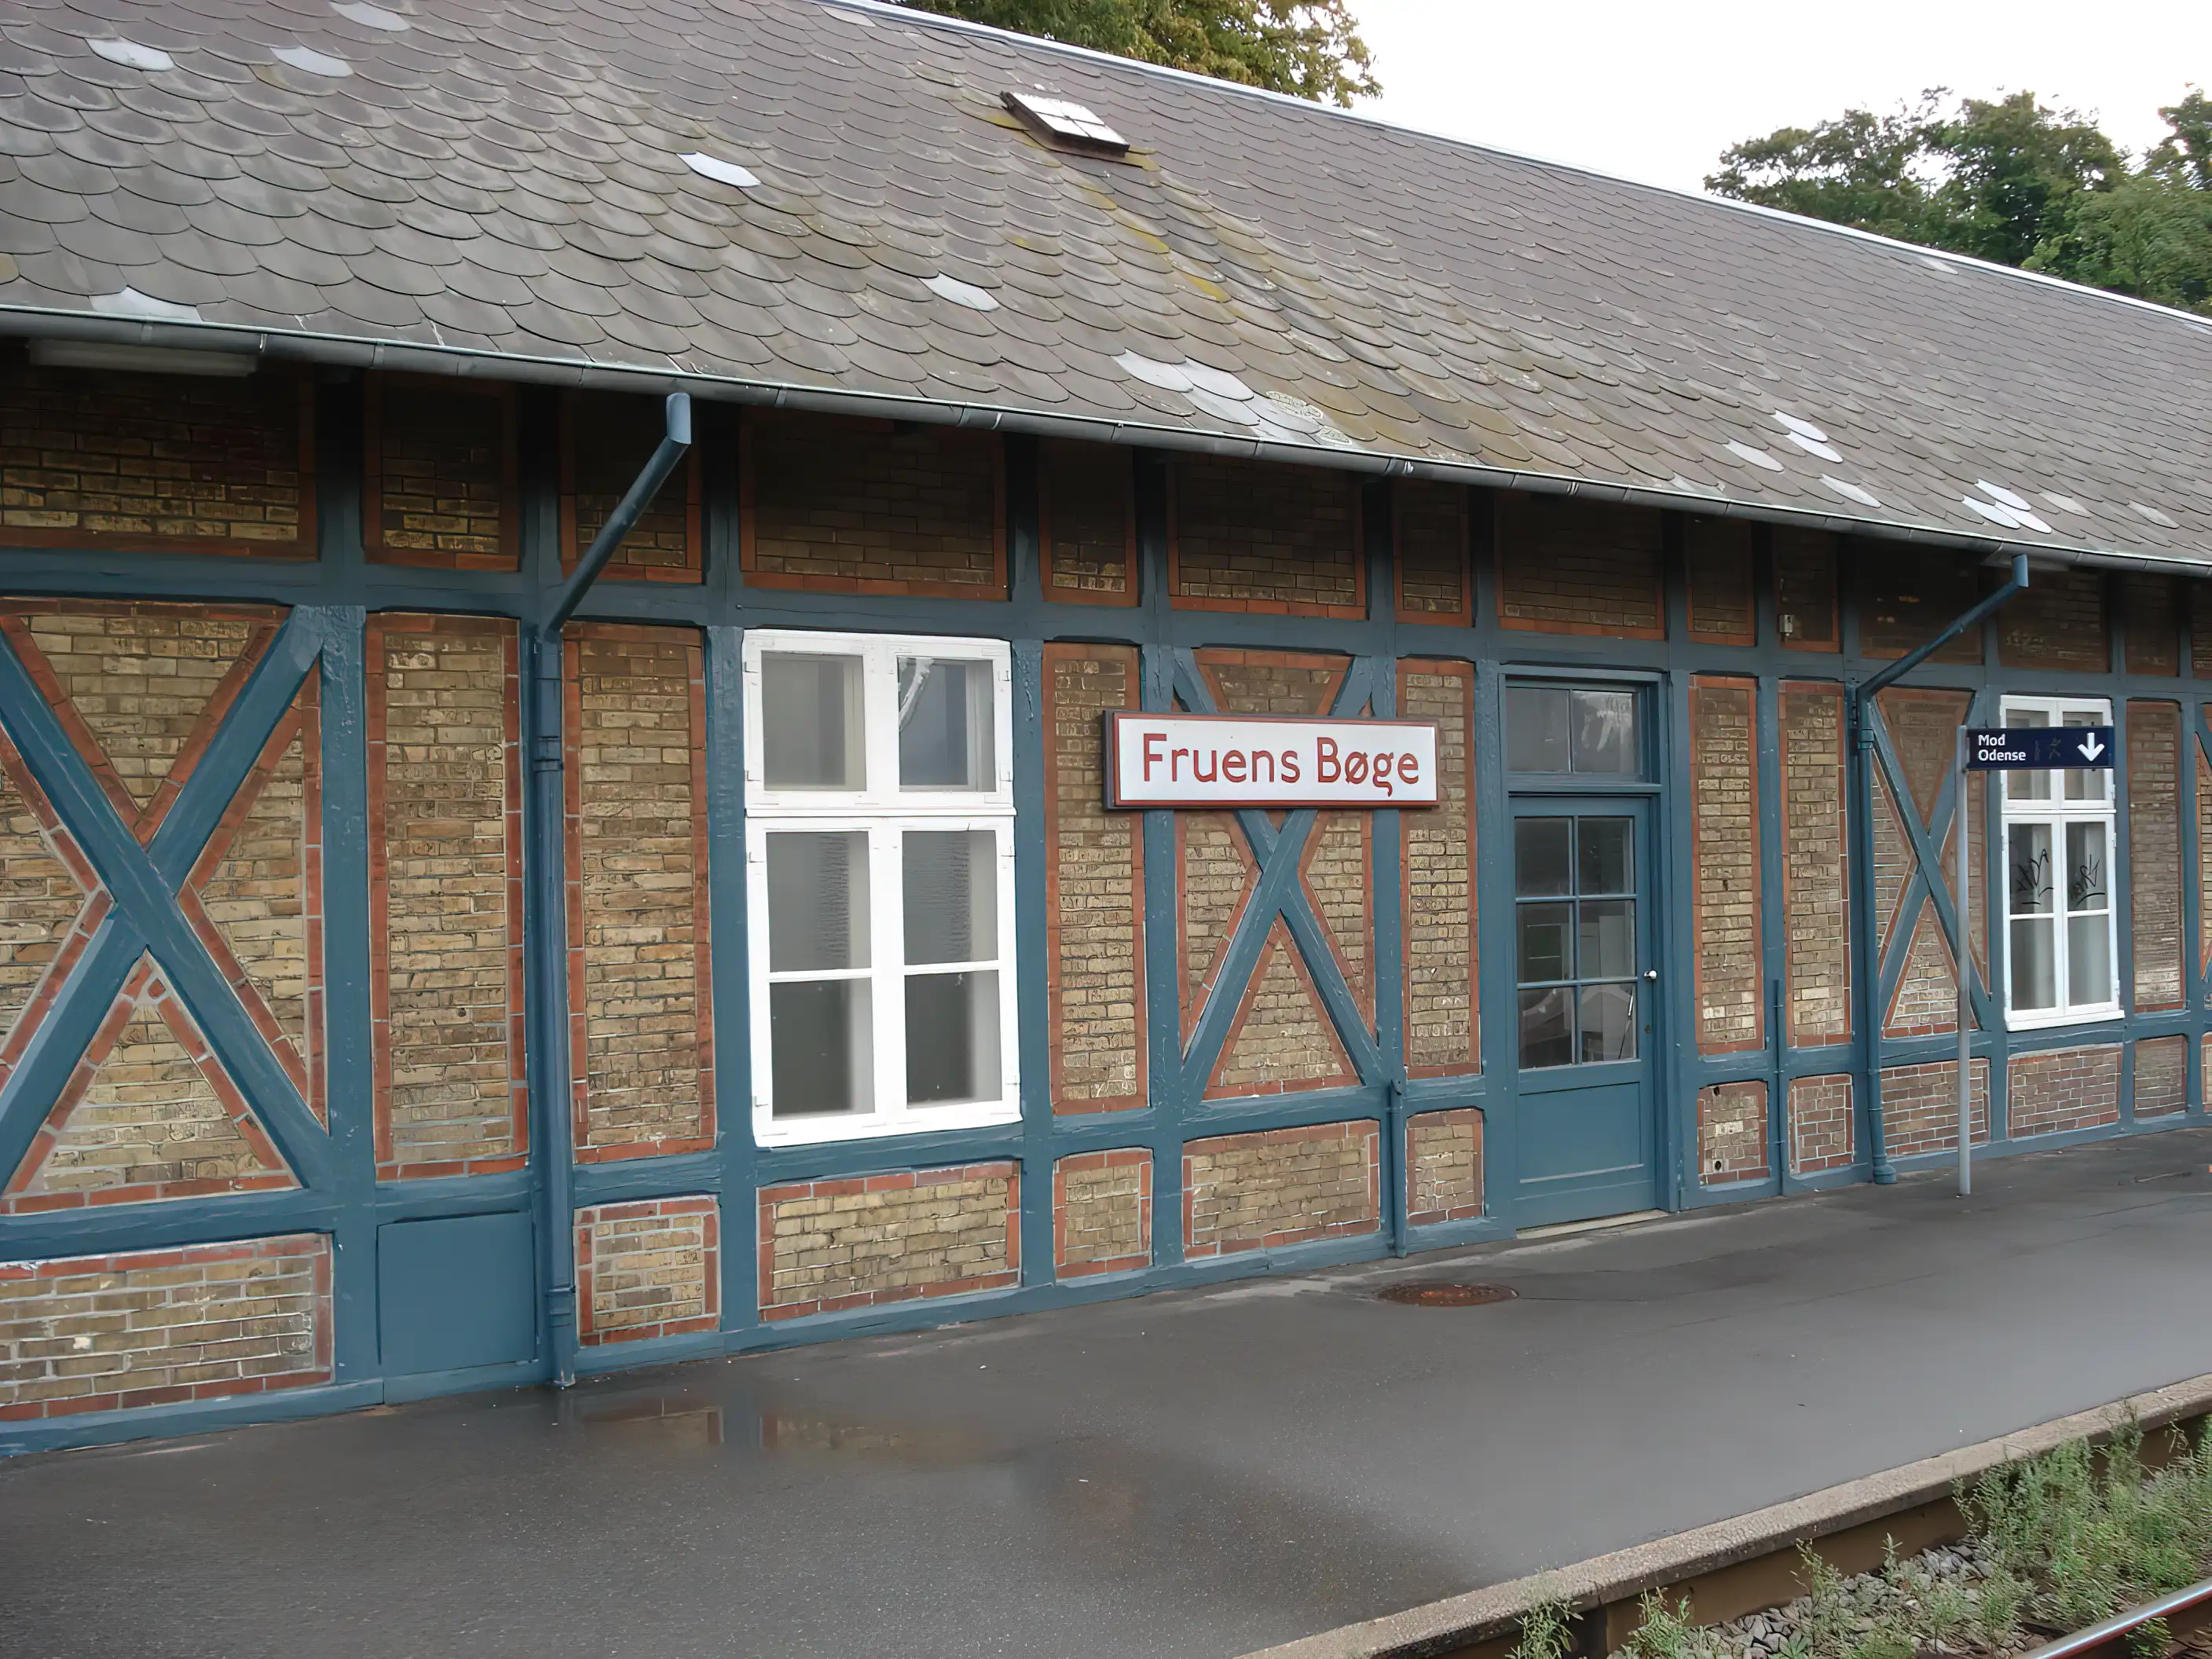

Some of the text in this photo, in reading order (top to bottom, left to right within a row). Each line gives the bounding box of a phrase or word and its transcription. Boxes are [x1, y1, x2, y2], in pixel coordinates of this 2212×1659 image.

[1978, 734, 2006, 746] Mod
[1978, 749, 2027, 761] Odense
[1143, 733, 1419, 797] Fruens Bøge
